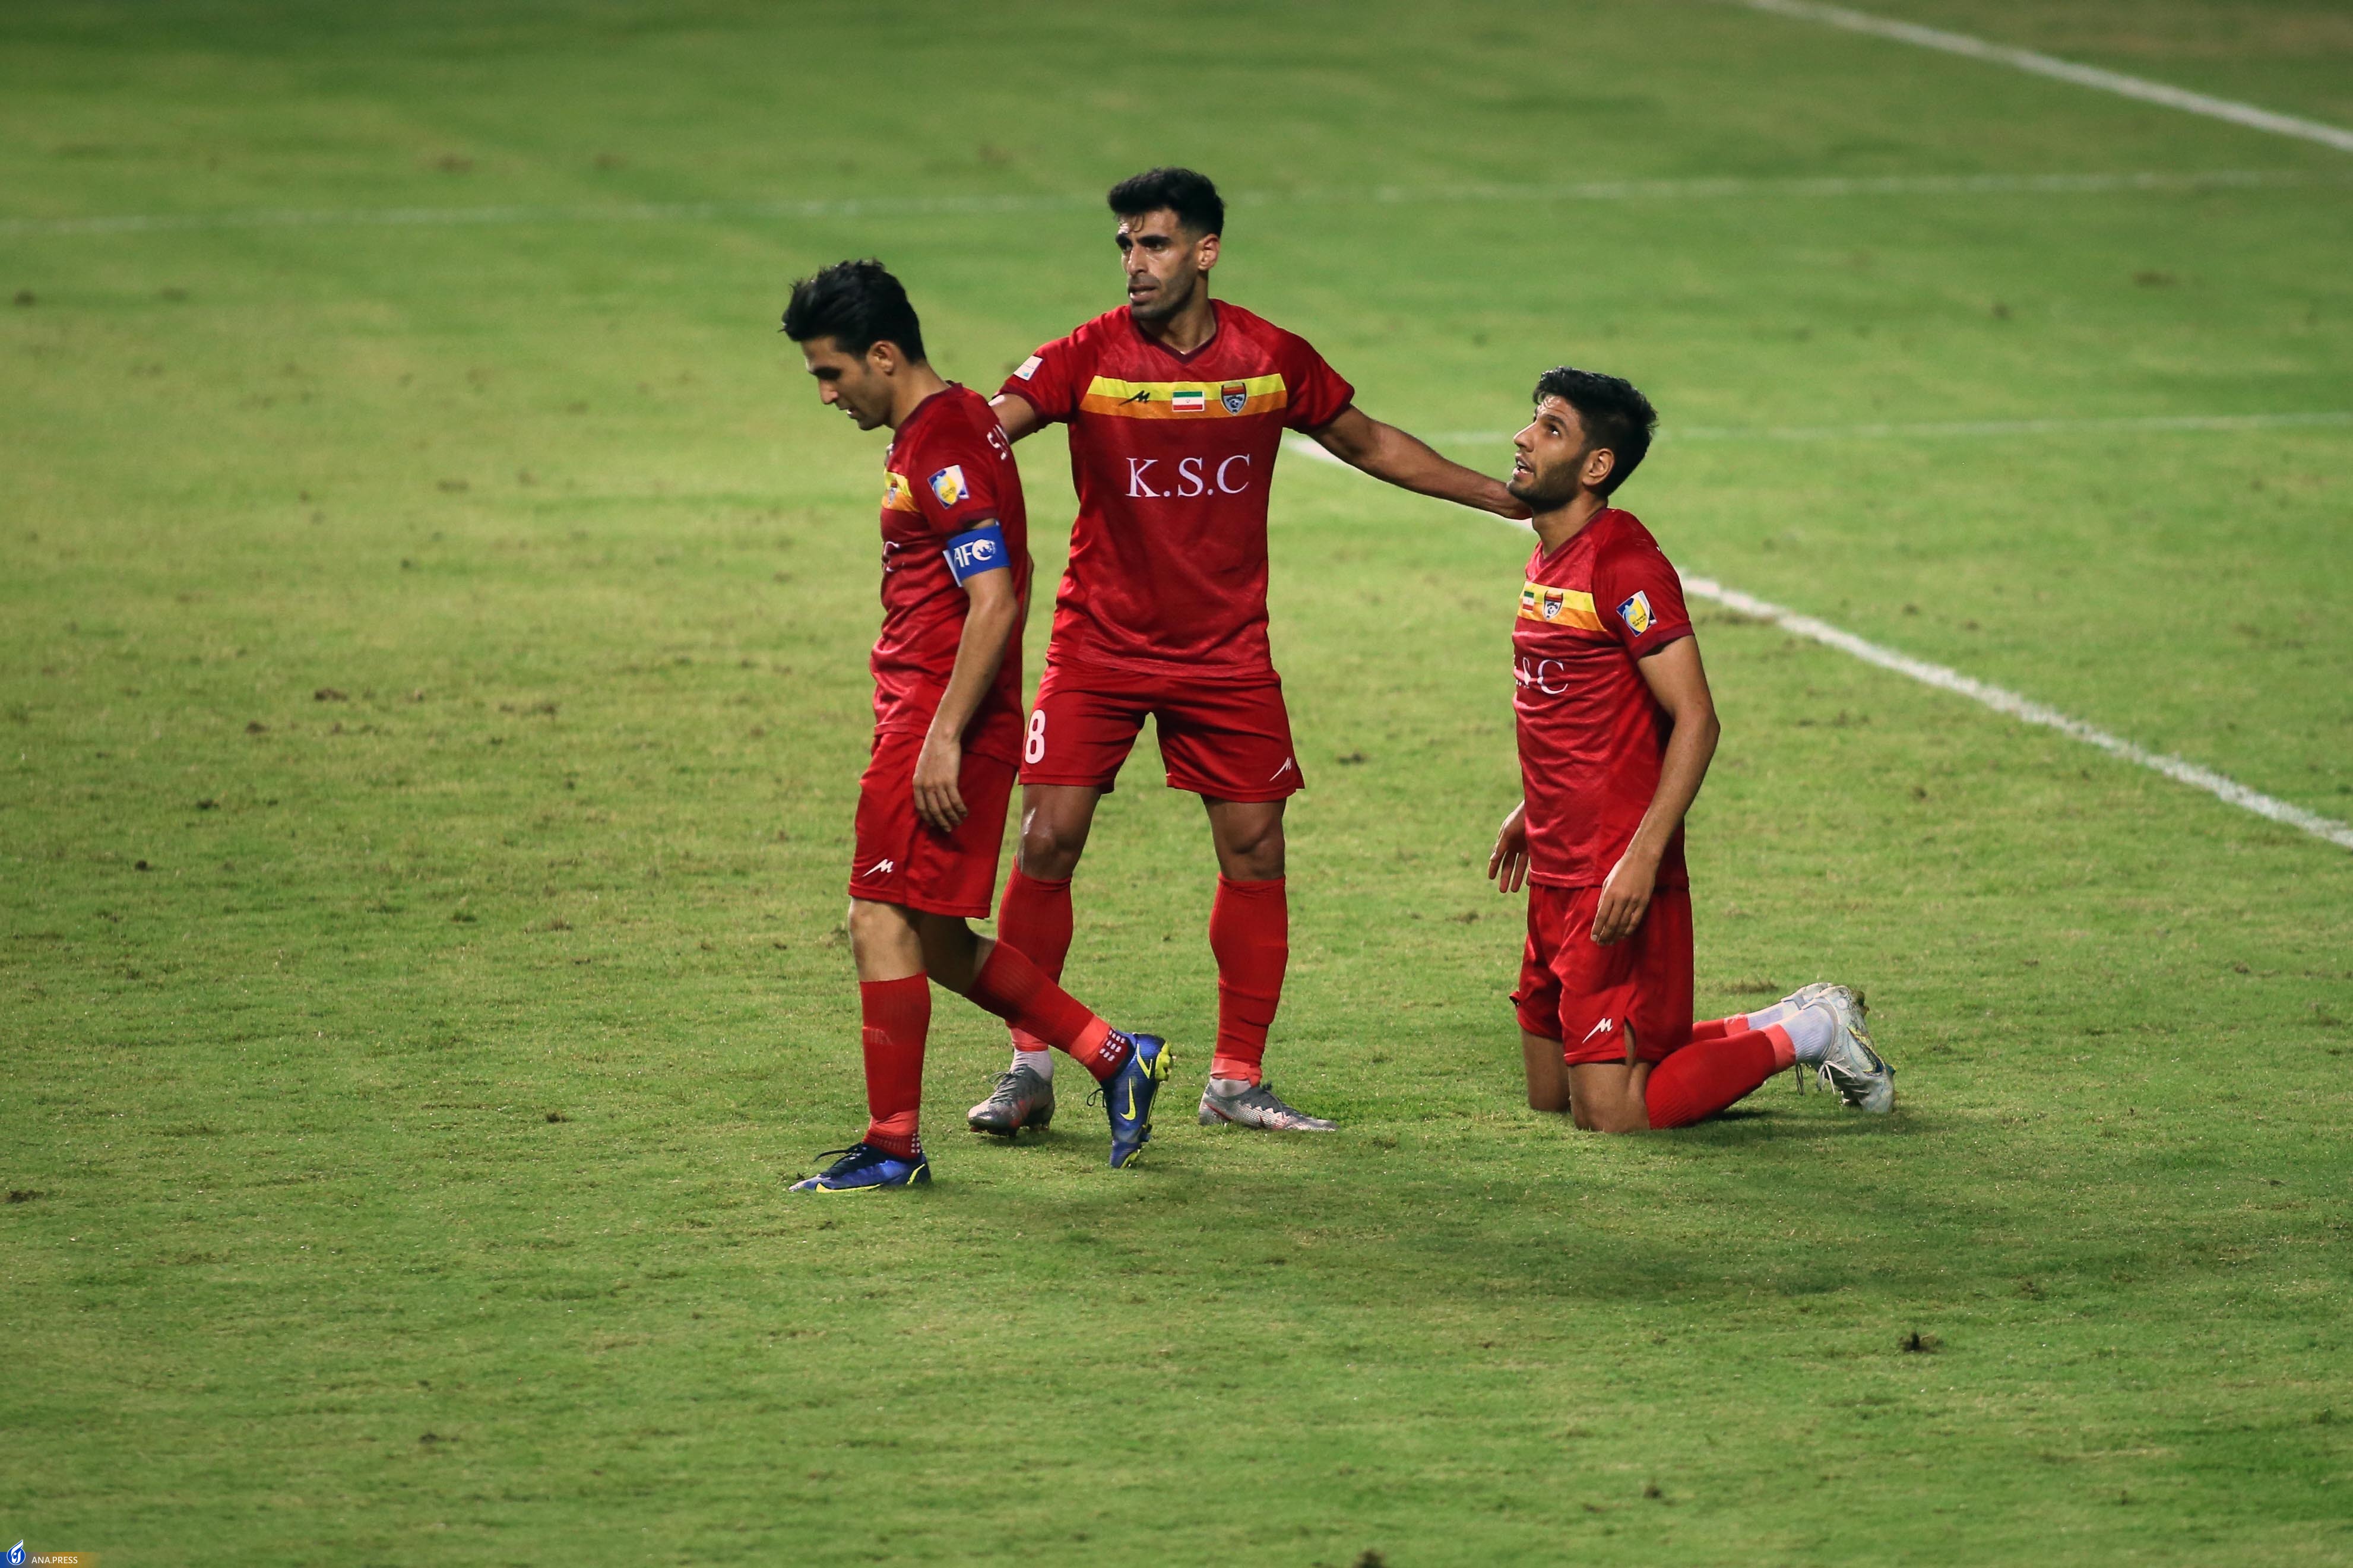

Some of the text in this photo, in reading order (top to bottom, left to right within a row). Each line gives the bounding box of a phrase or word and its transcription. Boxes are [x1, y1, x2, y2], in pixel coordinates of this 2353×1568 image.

[1125, 454, 1250, 498] K.S.C
[952, 538, 996, 568] AFC
[1025, 709, 1046, 765] 8
